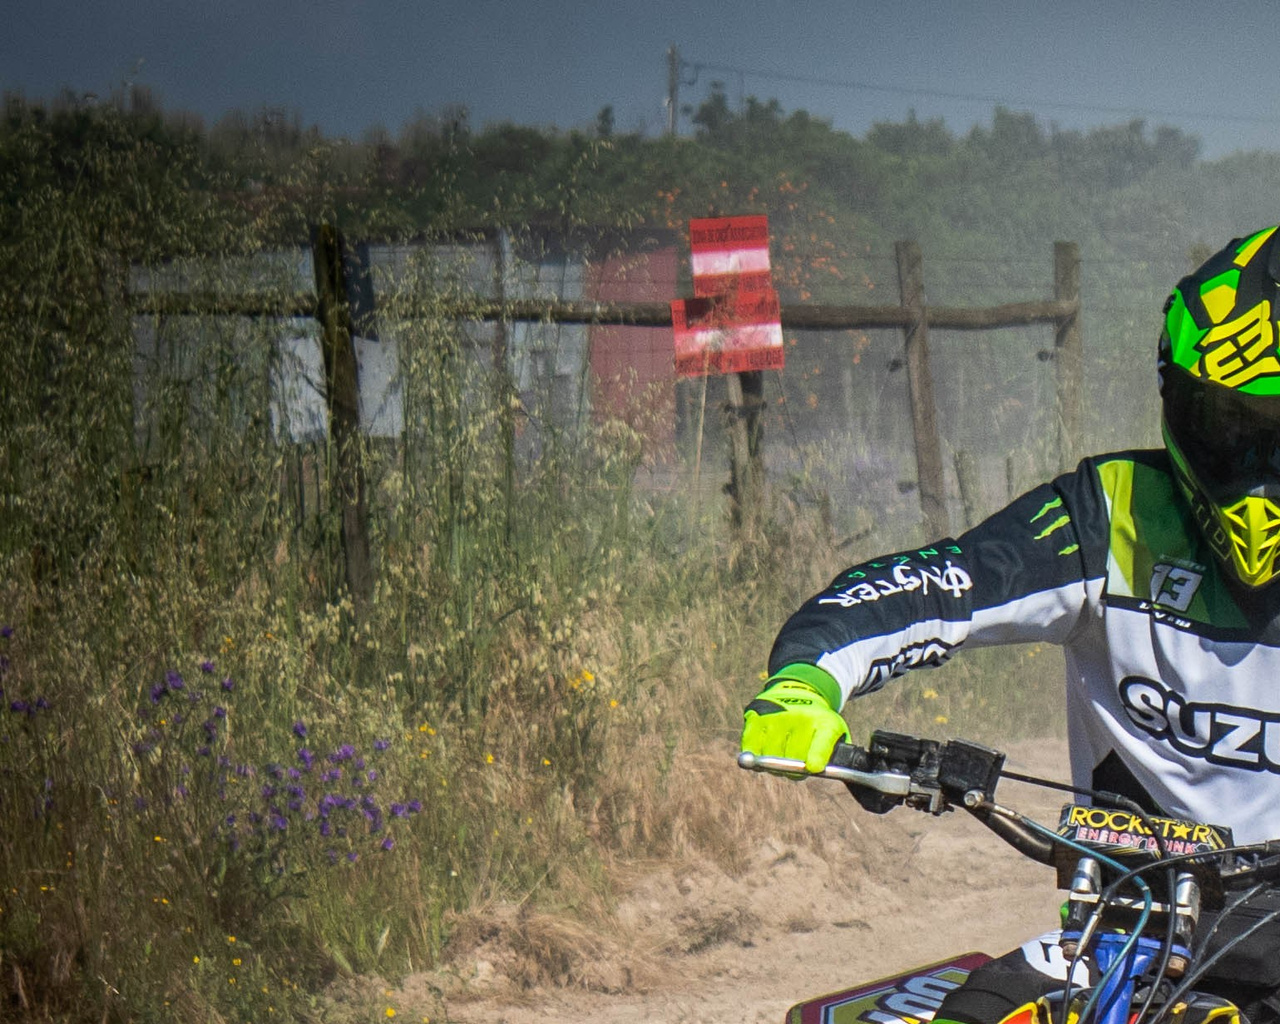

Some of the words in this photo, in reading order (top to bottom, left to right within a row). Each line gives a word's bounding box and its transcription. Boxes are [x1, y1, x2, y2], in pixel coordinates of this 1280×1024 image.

[1151, 564, 1204, 613] 13
[1077, 827, 1142, 848] ENERGY
[1146, 836, 1197, 855] DINK
